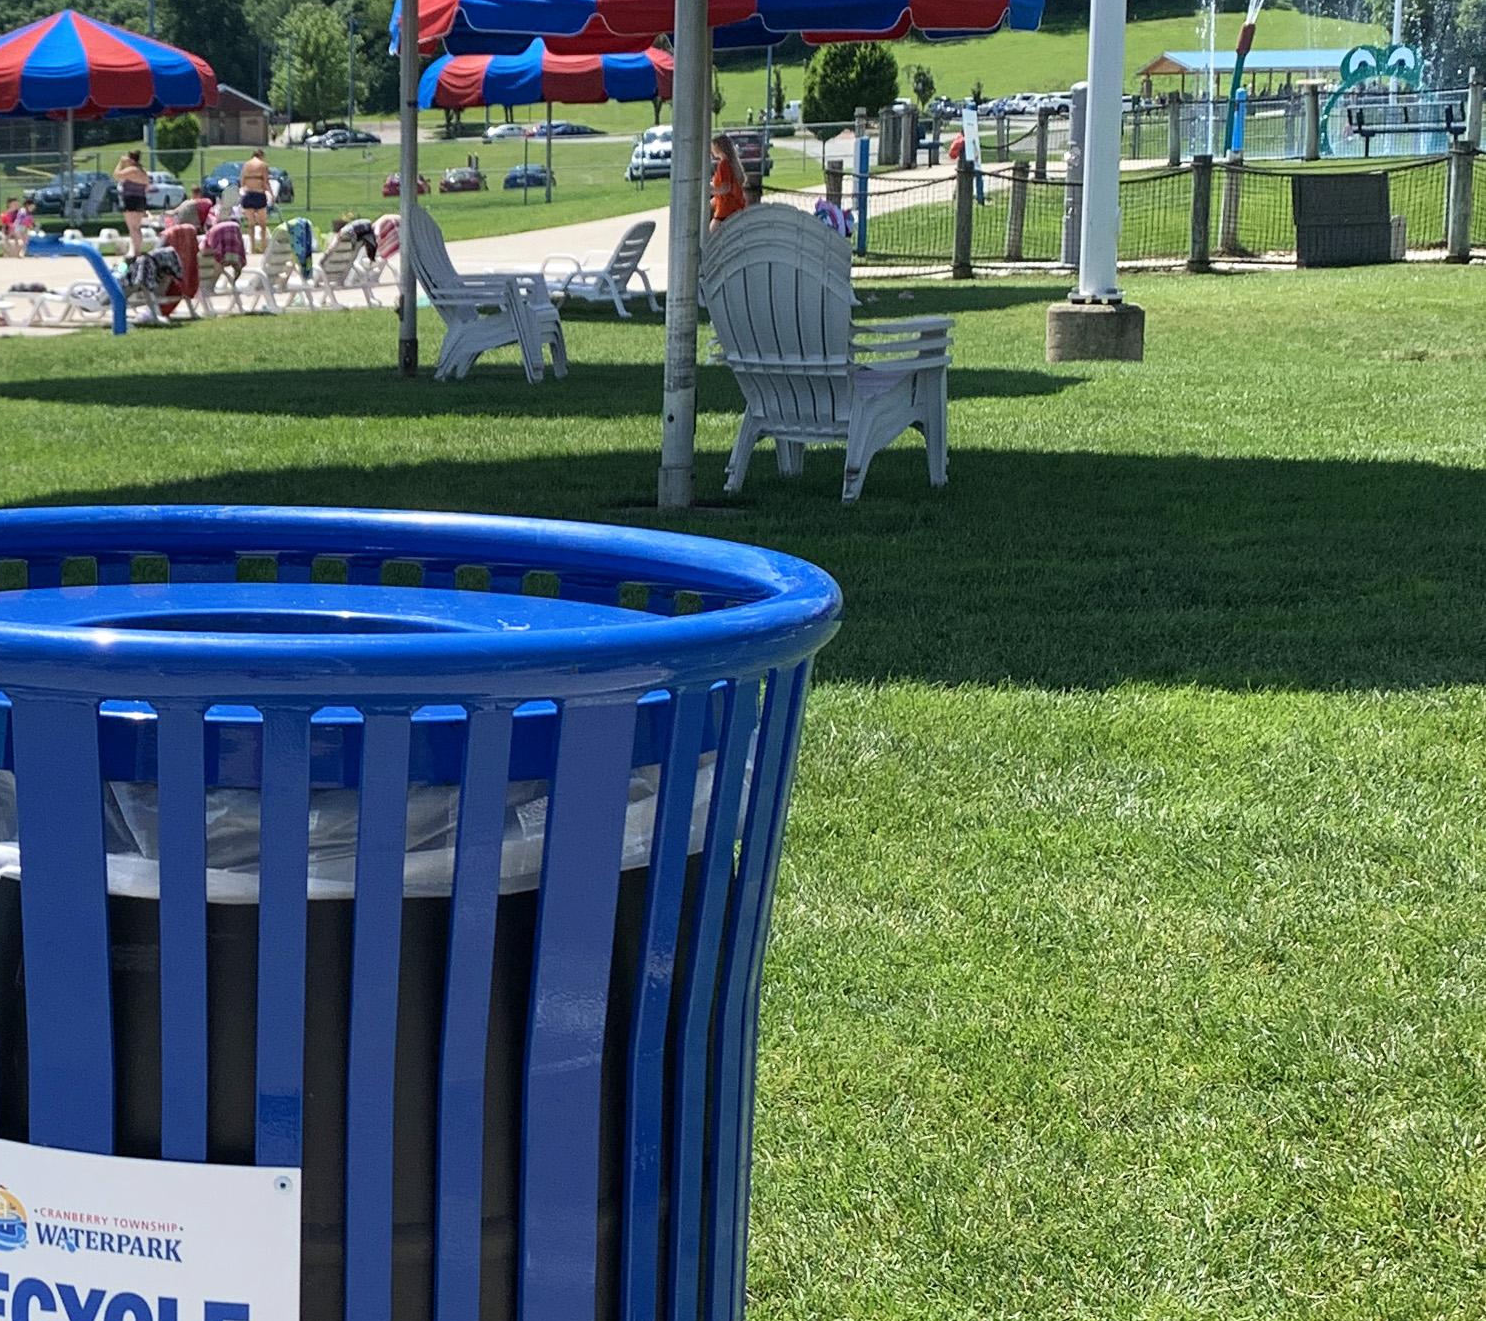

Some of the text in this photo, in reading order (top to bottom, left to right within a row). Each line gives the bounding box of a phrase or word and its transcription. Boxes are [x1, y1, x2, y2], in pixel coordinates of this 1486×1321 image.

[40, 1207, 178, 1233] CRANBERRY TOWNSHIP
[35, 1221, 183, 1263] WATERPARK
